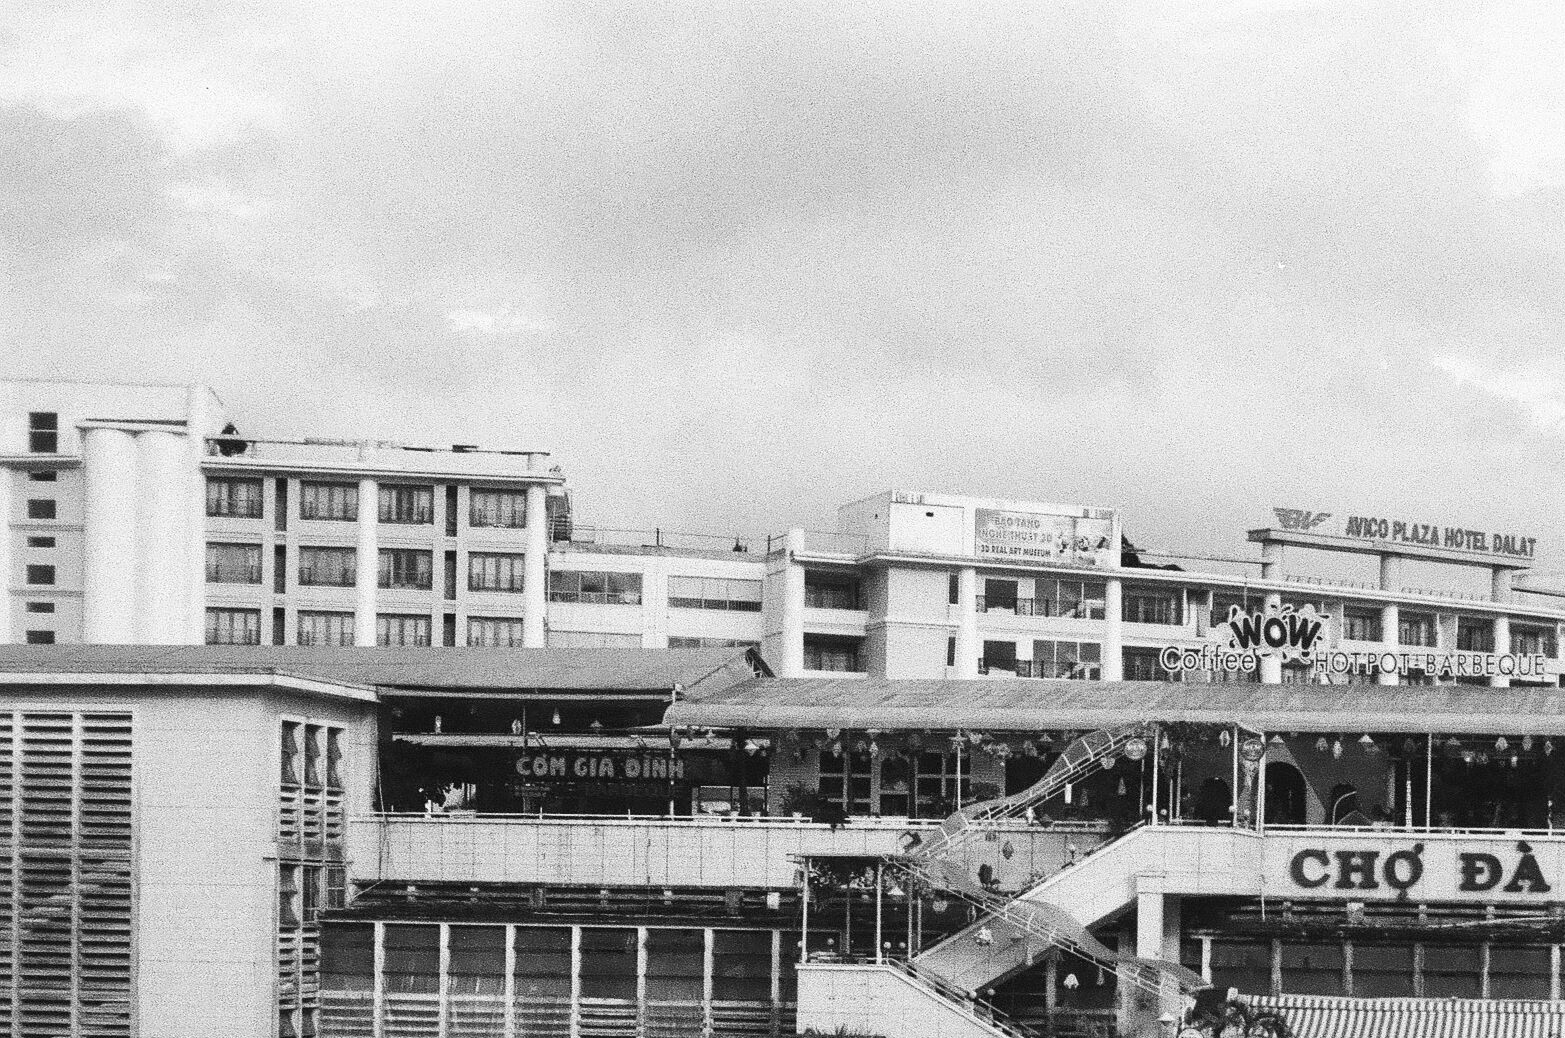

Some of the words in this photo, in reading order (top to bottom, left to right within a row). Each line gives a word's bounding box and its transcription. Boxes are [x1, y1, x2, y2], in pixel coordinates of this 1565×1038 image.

[1346, 516, 1389, 539] AVICO
[1392, 521, 1439, 546] PLAZA
[1444, 527, 1489, 551] HOTEL
[1493, 534, 1537, 557] DALAT
[1230, 617, 1322, 649] WOW
[1160, 645, 1256, 673] Coffee
[574, 757, 614, 777] GIA
[1290, 843, 1425, 900] CHỢ
[1460, 840, 1551, 892] ĐÀ
